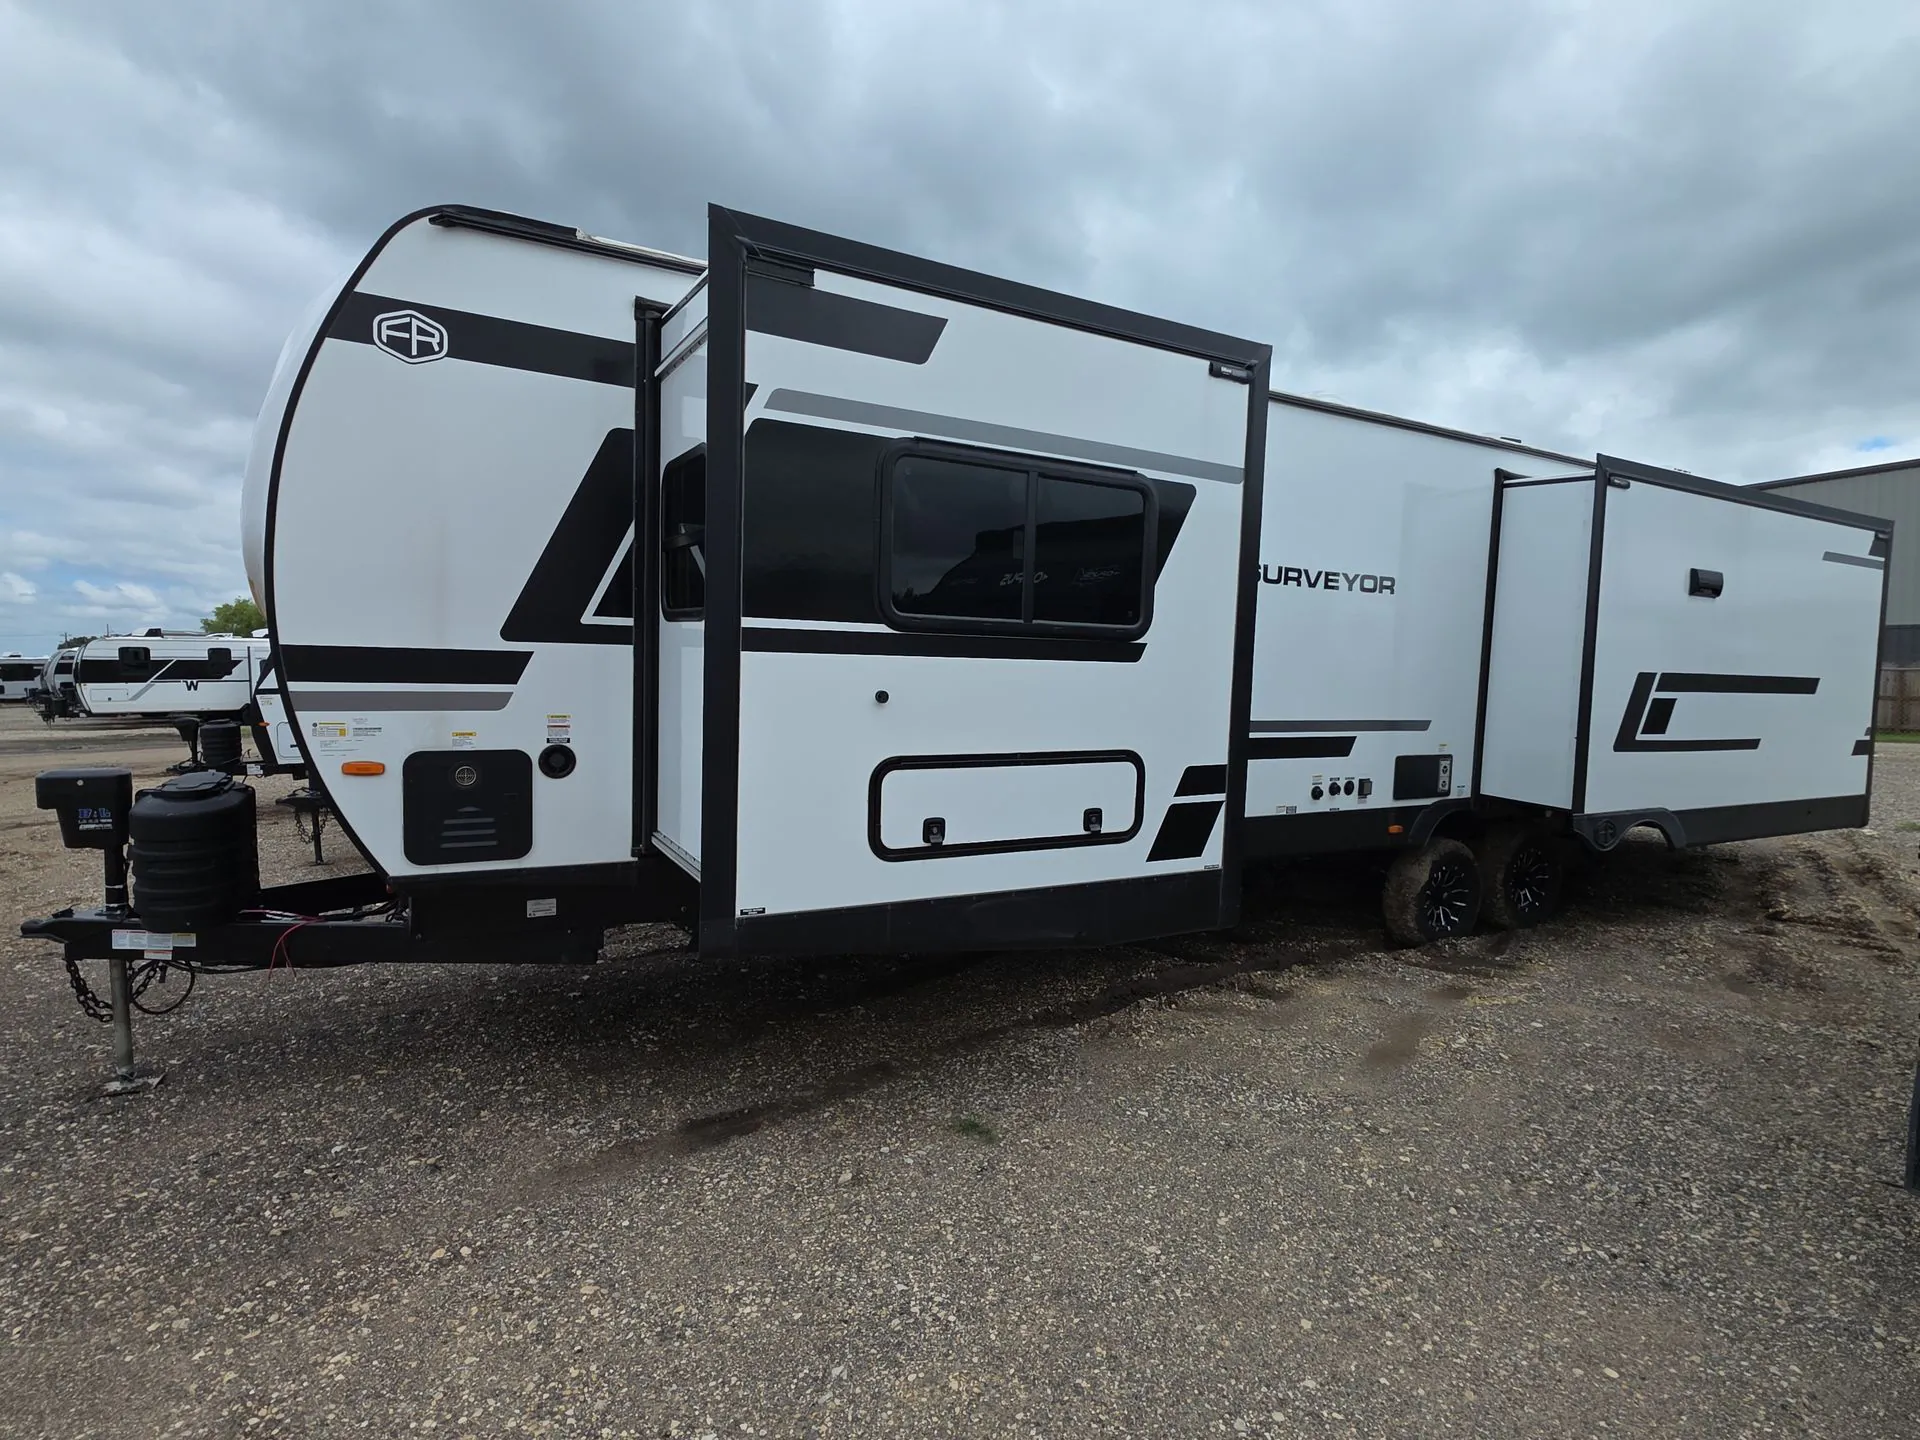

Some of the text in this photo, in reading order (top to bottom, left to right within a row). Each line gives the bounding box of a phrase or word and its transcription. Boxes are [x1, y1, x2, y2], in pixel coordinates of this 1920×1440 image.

[381, 316, 440, 355] FR
[1256, 564, 1396, 594] URVEYOR
[184, 680, 199, 691] W
